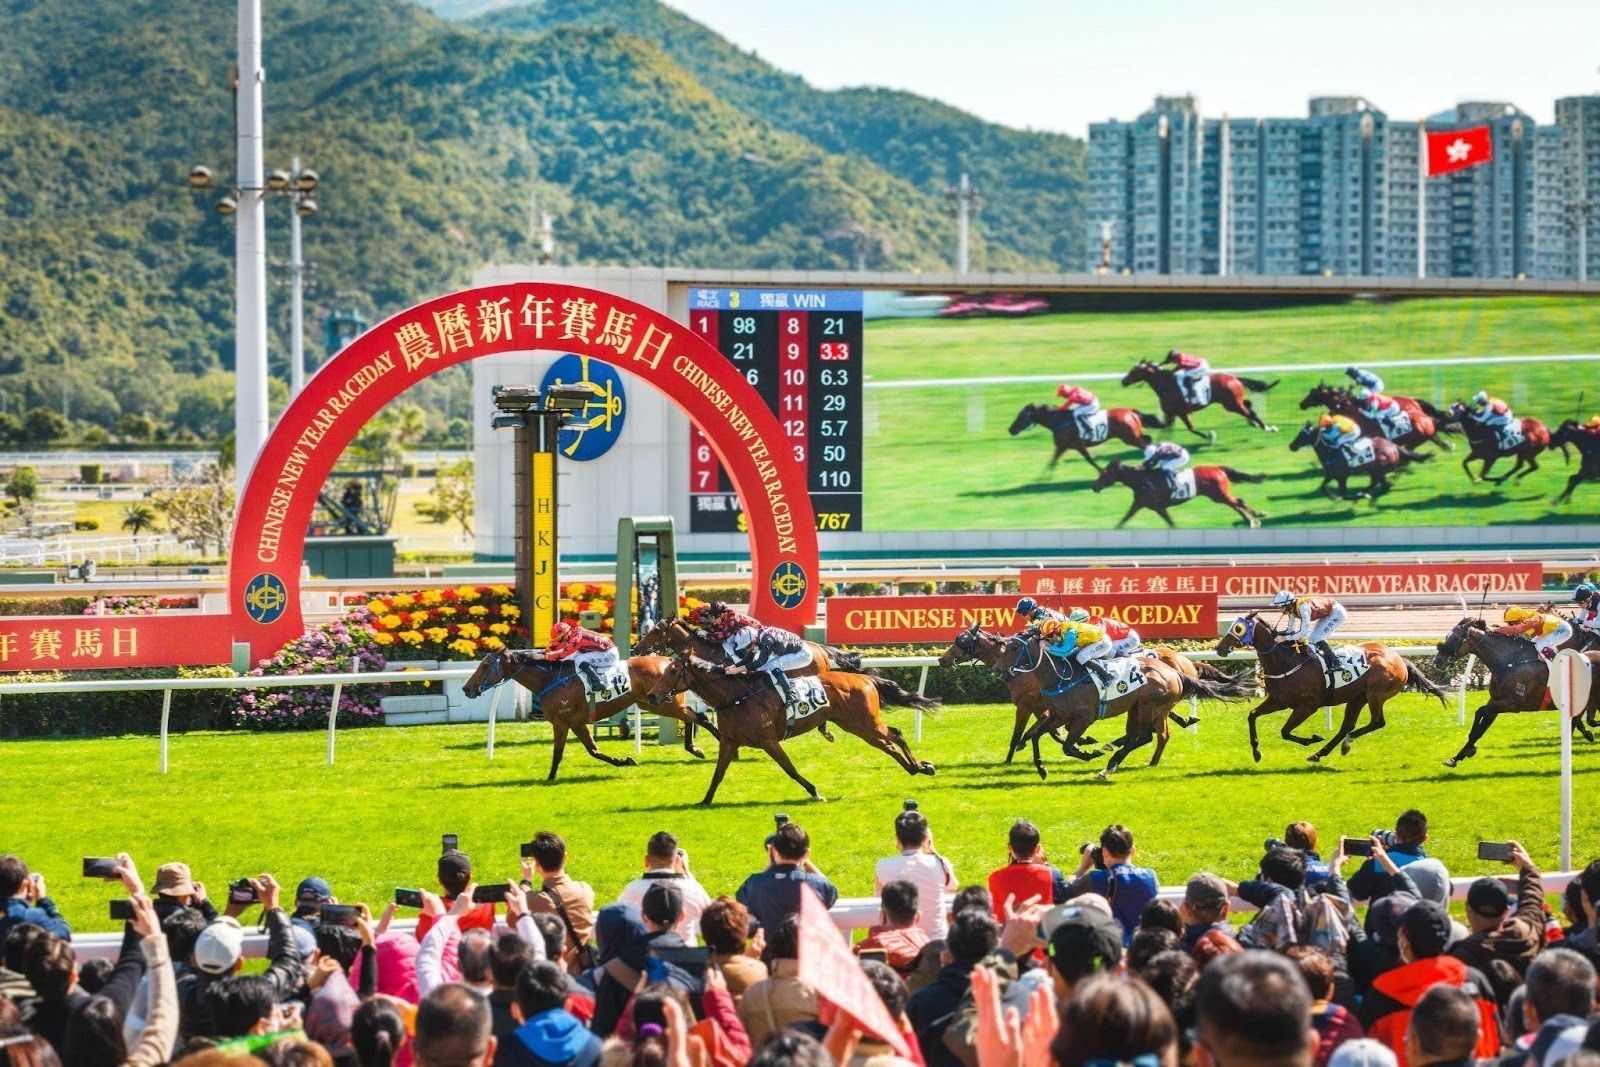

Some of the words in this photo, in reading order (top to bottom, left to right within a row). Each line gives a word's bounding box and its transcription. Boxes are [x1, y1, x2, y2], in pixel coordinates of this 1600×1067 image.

[696, 300, 720, 308] RACE
[728, 291, 740, 309] 3
[793, 294, 826, 308] WIN
[393, 294, 673, 372] 農曆新年賽馬日
[698, 317, 708, 333] 1
[733, 317, 757, 334] 98
[787, 318, 800, 334] 8
[823, 318, 845, 335] 21
[733, 342, 754, 360] 21
[787, 343, 800, 360] 9
[820, 343, 849, 360] 3.3
[783, 369, 805, 386] 10
[820, 369, 849, 386] 6.3
[784, 395, 804, 411] 11
[823, 395, 846, 412] 29
[783, 420, 805, 437] 12
[820, 420, 848, 437] 5.7
[258, 486, 292, 563] CHINESE
[278, 445, 310, 491] NEW
[296, 408, 339, 451] YEAR
[326, 350, 396, 415] RACEDAY
[672, 355, 733, 412] CHINESE
[724, 404, 759, 442] NEW
[747, 437, 778, 482] YEAR
[764, 478, 797, 554] RACEDAY
[697, 445, 710, 463] 6
[822, 446, 846, 463] 50
[697, 471, 710, 488] 7
[819, 471, 851, 488] 110
[1225, 576, 1320, 596] CHINESE
[1324, 575, 1376, 594] NEW
[1377, 575, 1431, 593] YEAR
[1433, 573, 1531, 593] RACEDAY
[845, 607, 956, 631] CHINESE
[959, 606, 1016, 628] NEW
[1129, 664, 1144, 685] 4
[610, 674, 630, 696] 12
